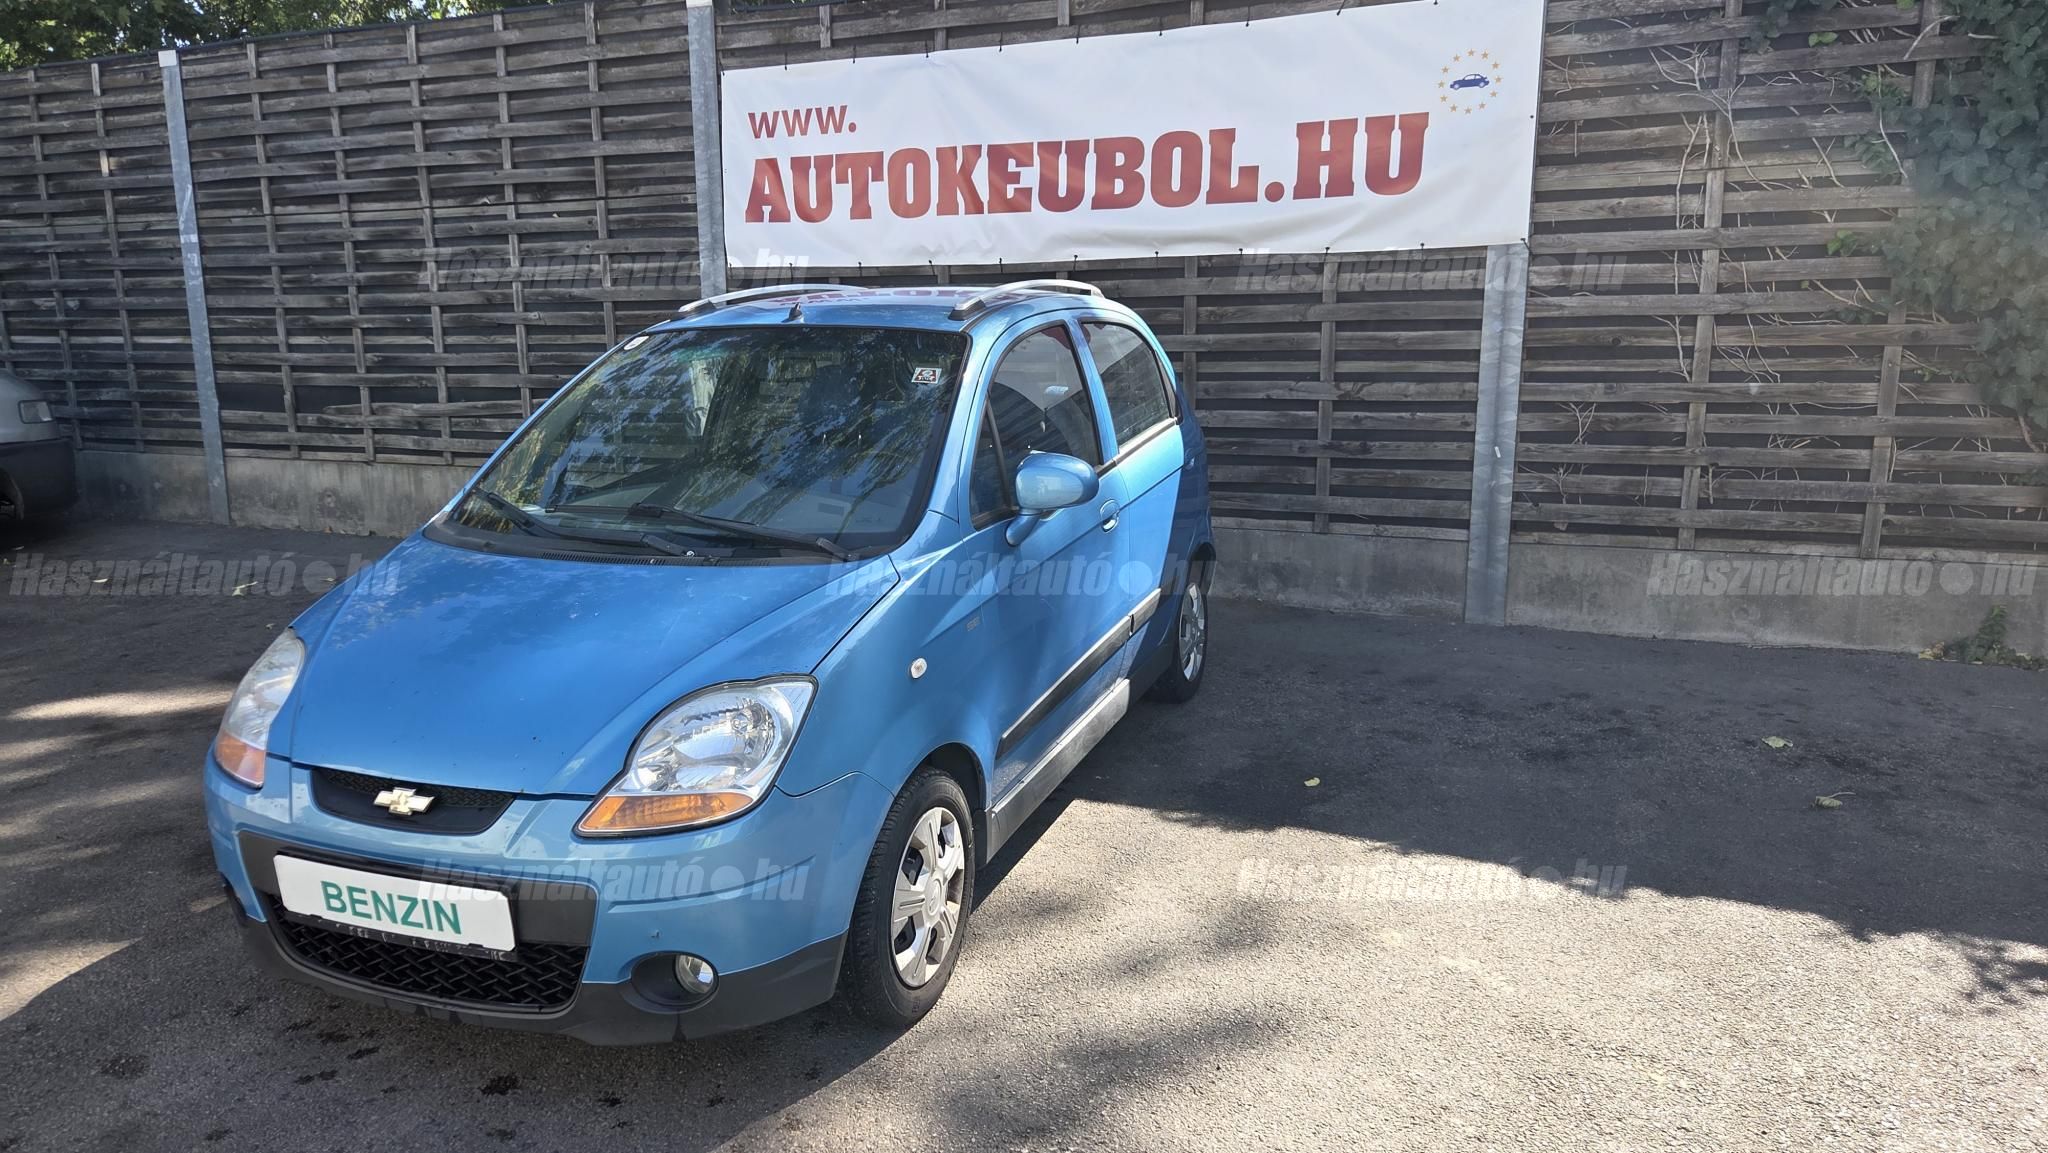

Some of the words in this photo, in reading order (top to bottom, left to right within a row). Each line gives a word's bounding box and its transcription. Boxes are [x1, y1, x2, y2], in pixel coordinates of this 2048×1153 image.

[748, 105, 857, 139] www.
[745, 112, 1430, 223] AUTOKEUBOL.HU
[321, 880, 462, 935] BENZIN
